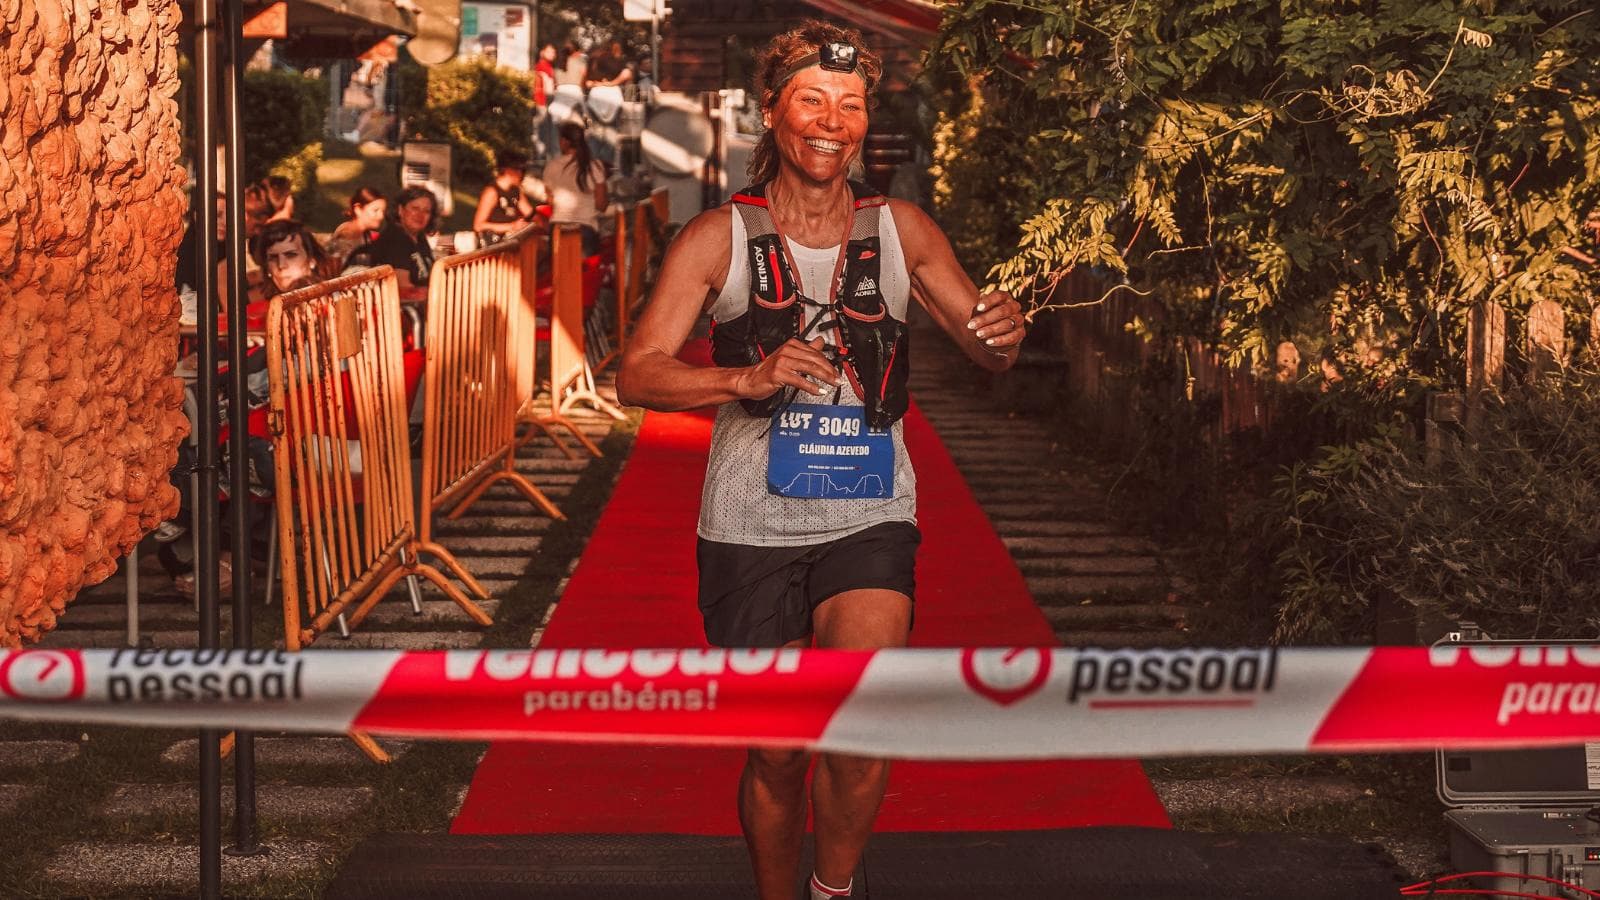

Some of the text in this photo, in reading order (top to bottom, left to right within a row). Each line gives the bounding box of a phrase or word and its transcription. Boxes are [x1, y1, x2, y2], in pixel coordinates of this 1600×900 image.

[753, 246, 768, 292] AONIJIE
[780, 411, 860, 437] LUT 3049
[798, 443, 870, 455] CLÁUDIA AZEVEDO
[108, 659, 303, 701] pessoal
[1067, 649, 1279, 704] pessoal
[524, 680, 719, 716] parabéns!
[1498, 682, 1600, 725] para
